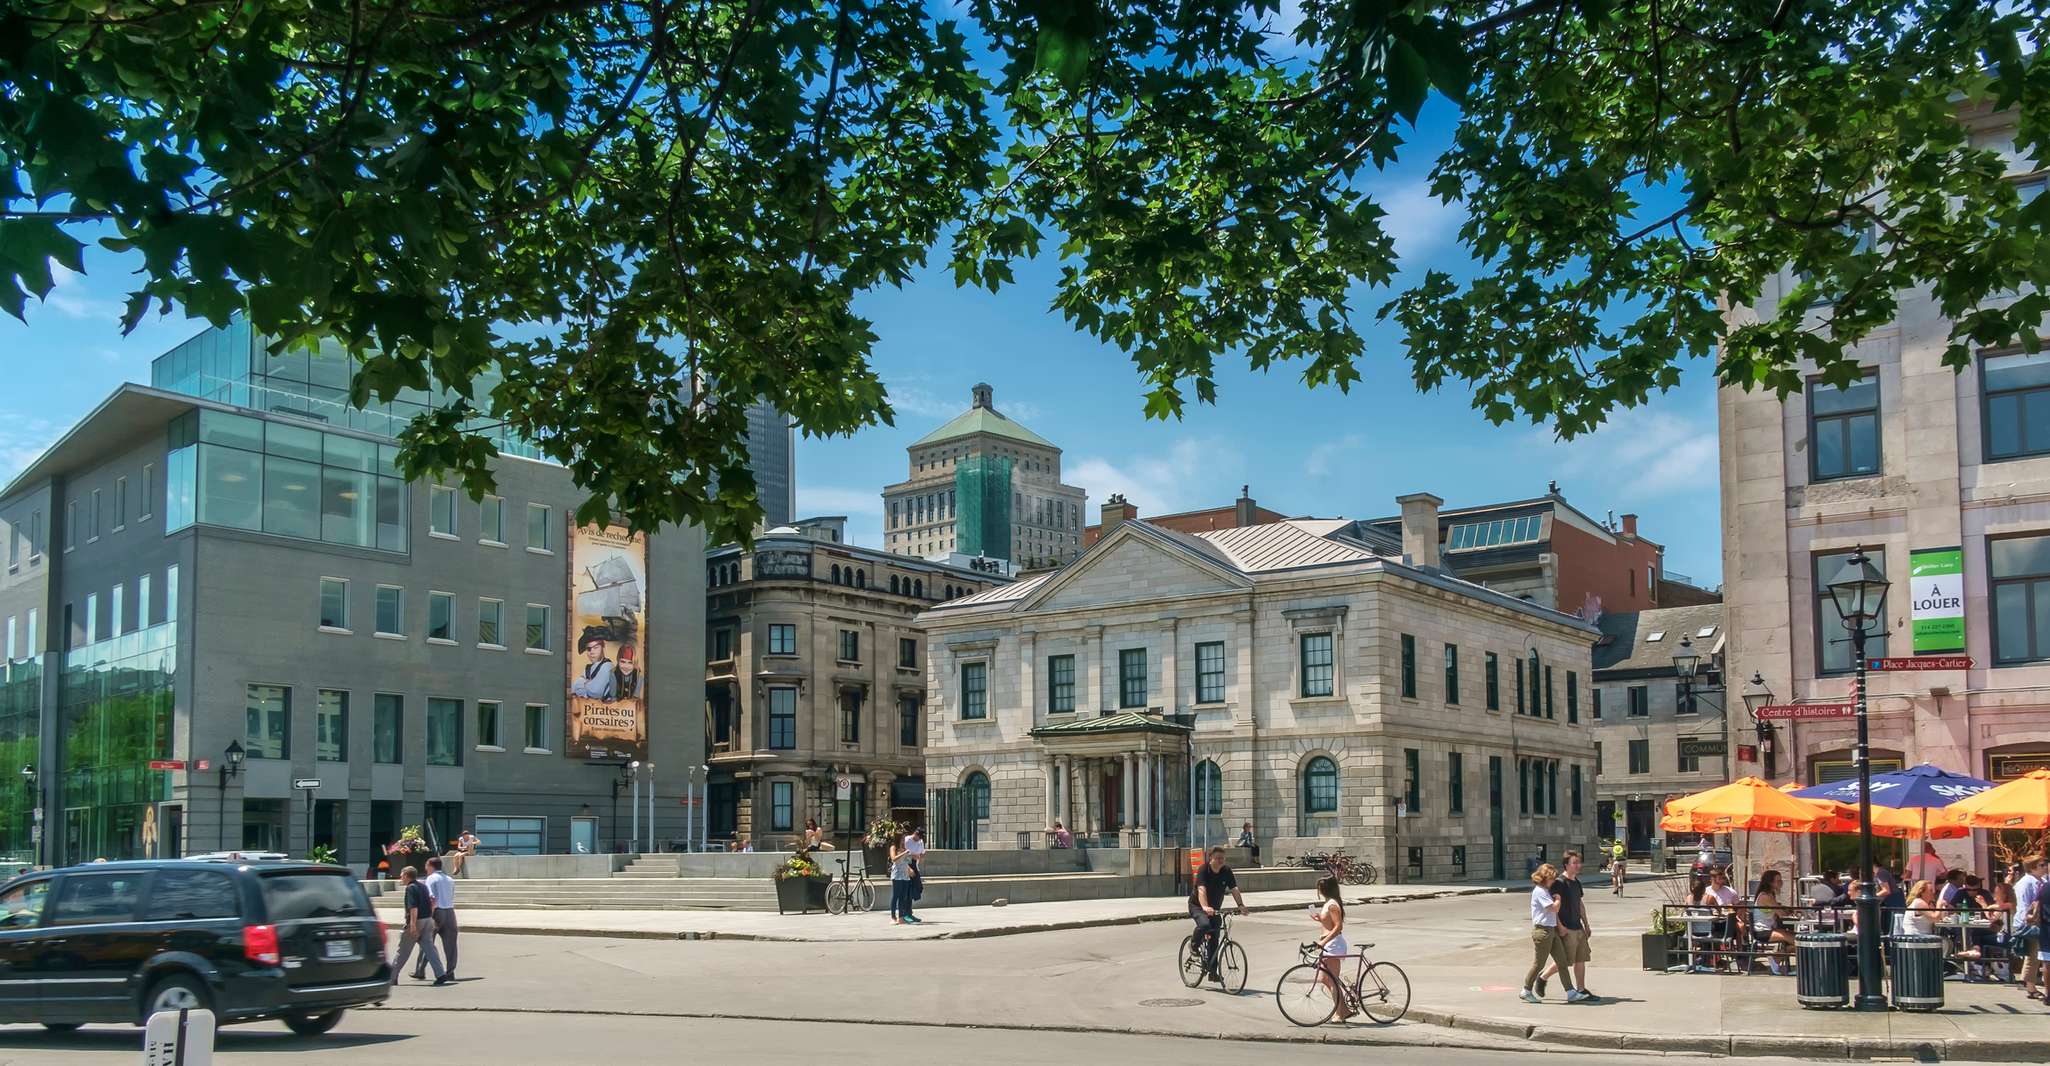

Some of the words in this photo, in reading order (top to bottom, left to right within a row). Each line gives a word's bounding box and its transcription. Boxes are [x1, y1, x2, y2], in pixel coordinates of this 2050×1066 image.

[577, 528, 595, 536] Avis
[1930, 583, 1941, 596] À
[1913, 597, 1961, 611] LOUER
[1883, 659, 1903, 669] Place
[1905, 657, 1966, 670] Jacques-Cartier
[584, 703, 620, 716] Pirates
[621, 708, 634, 718] ou
[1761, 707, 1792, 717] Centre
[1794, 704, 1836, 716] d'histoire
